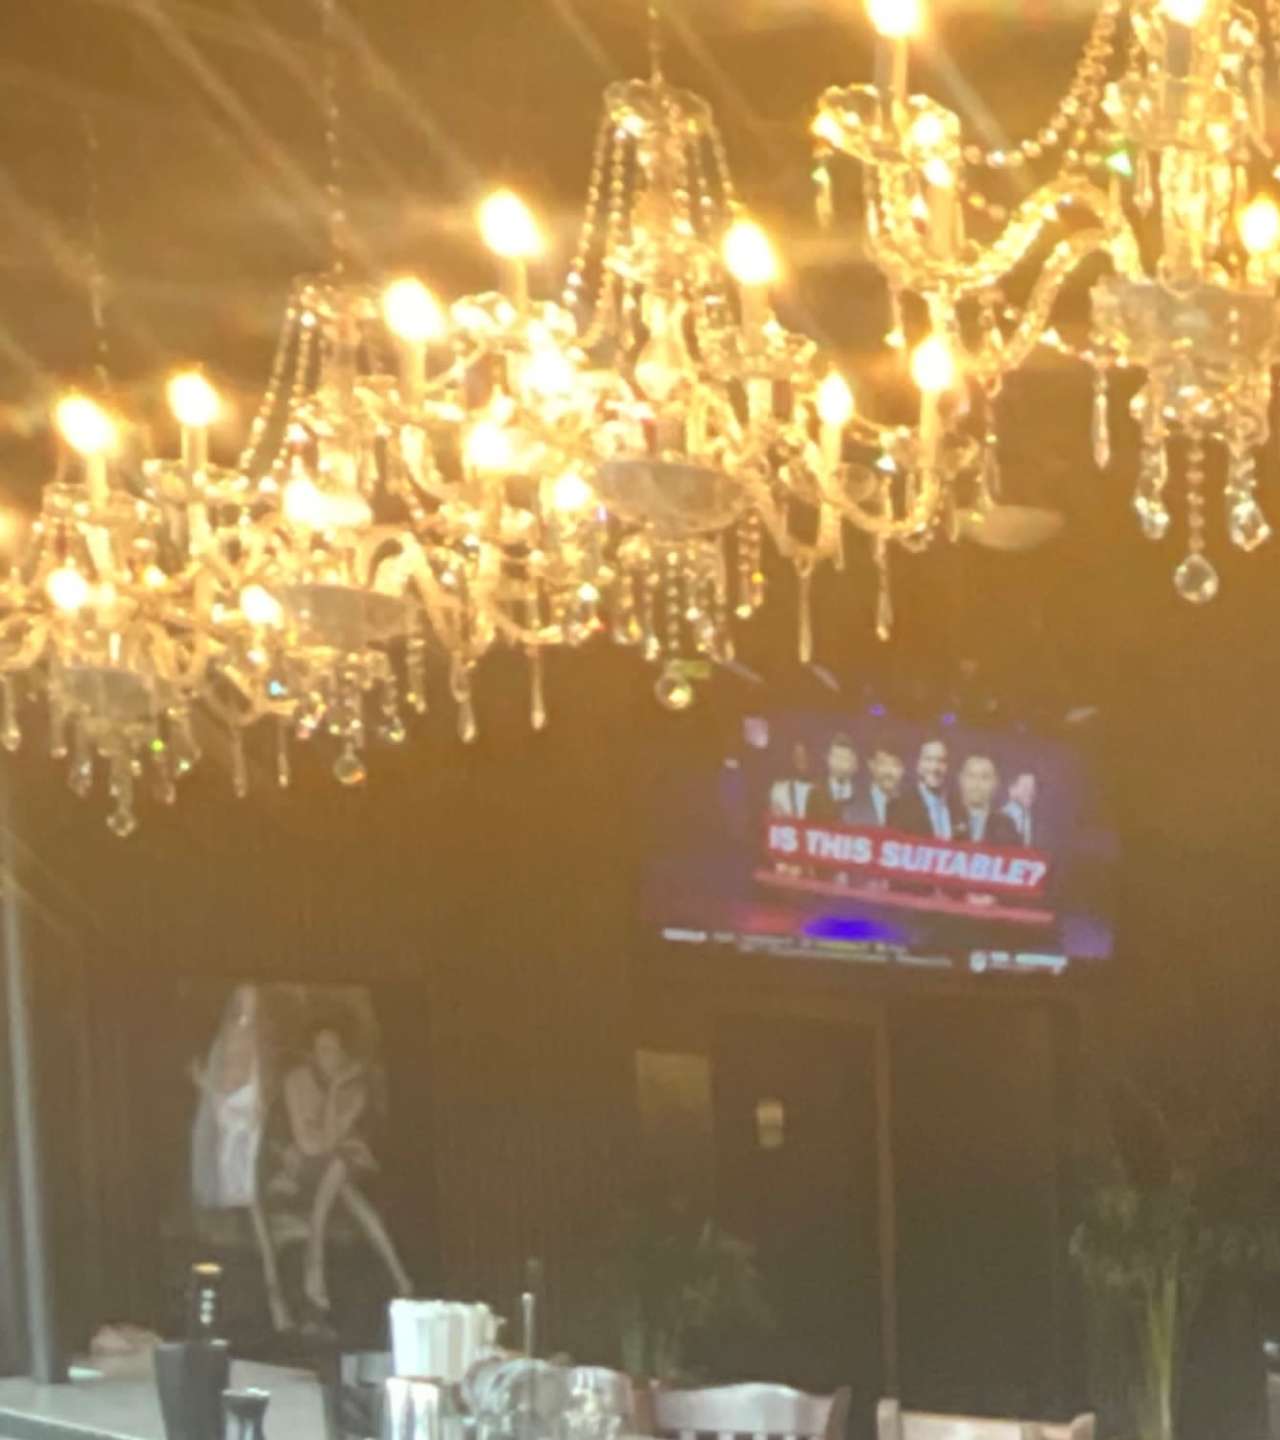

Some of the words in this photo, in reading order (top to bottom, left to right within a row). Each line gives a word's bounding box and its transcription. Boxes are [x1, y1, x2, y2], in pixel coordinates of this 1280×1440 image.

[768, 825, 798, 852] IS
[805, 829, 872, 864] THIS
[880, 841, 1047, 887] SUITABLE?
